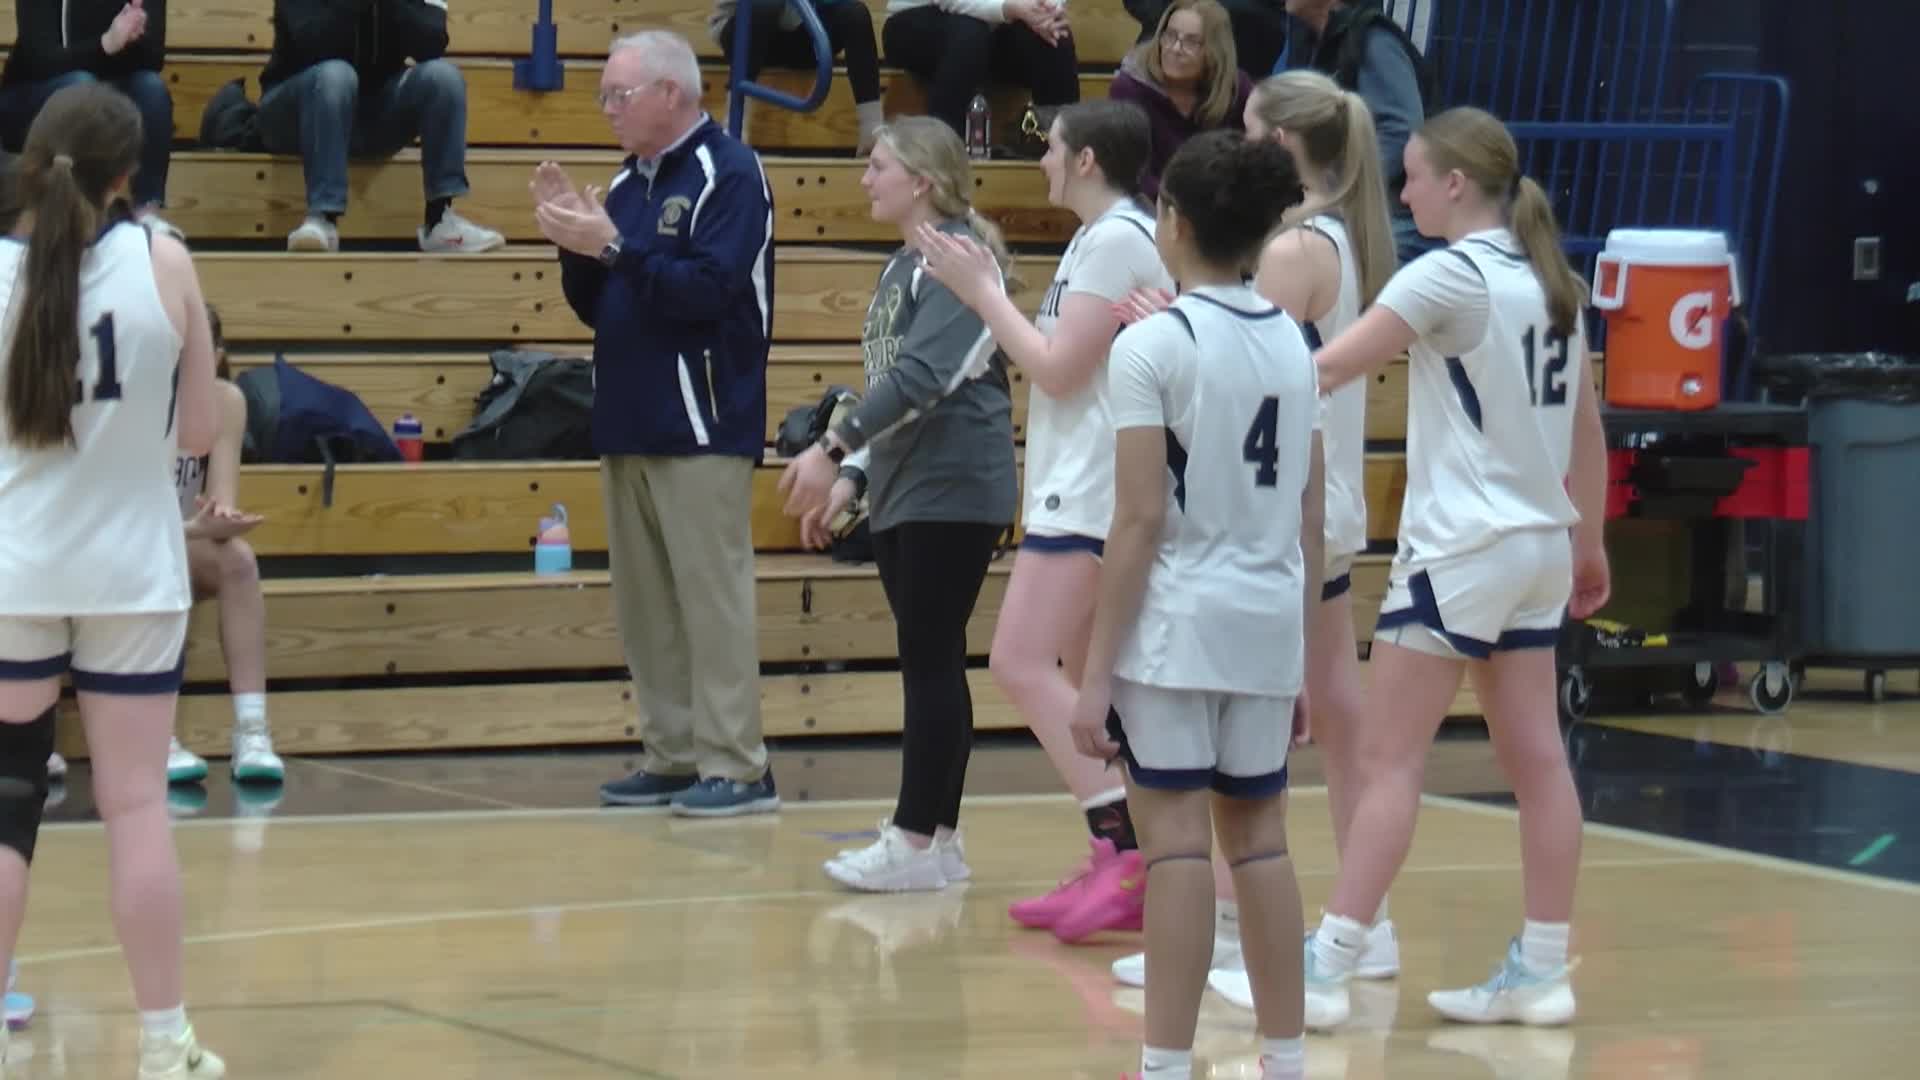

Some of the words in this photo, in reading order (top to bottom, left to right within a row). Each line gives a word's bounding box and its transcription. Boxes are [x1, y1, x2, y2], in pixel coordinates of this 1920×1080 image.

[73, 310, 122, 403] 1
[1669, 292, 1713, 350] G
[1521, 324, 1568, 406] 12
[1242, 395, 1279, 488] 4
